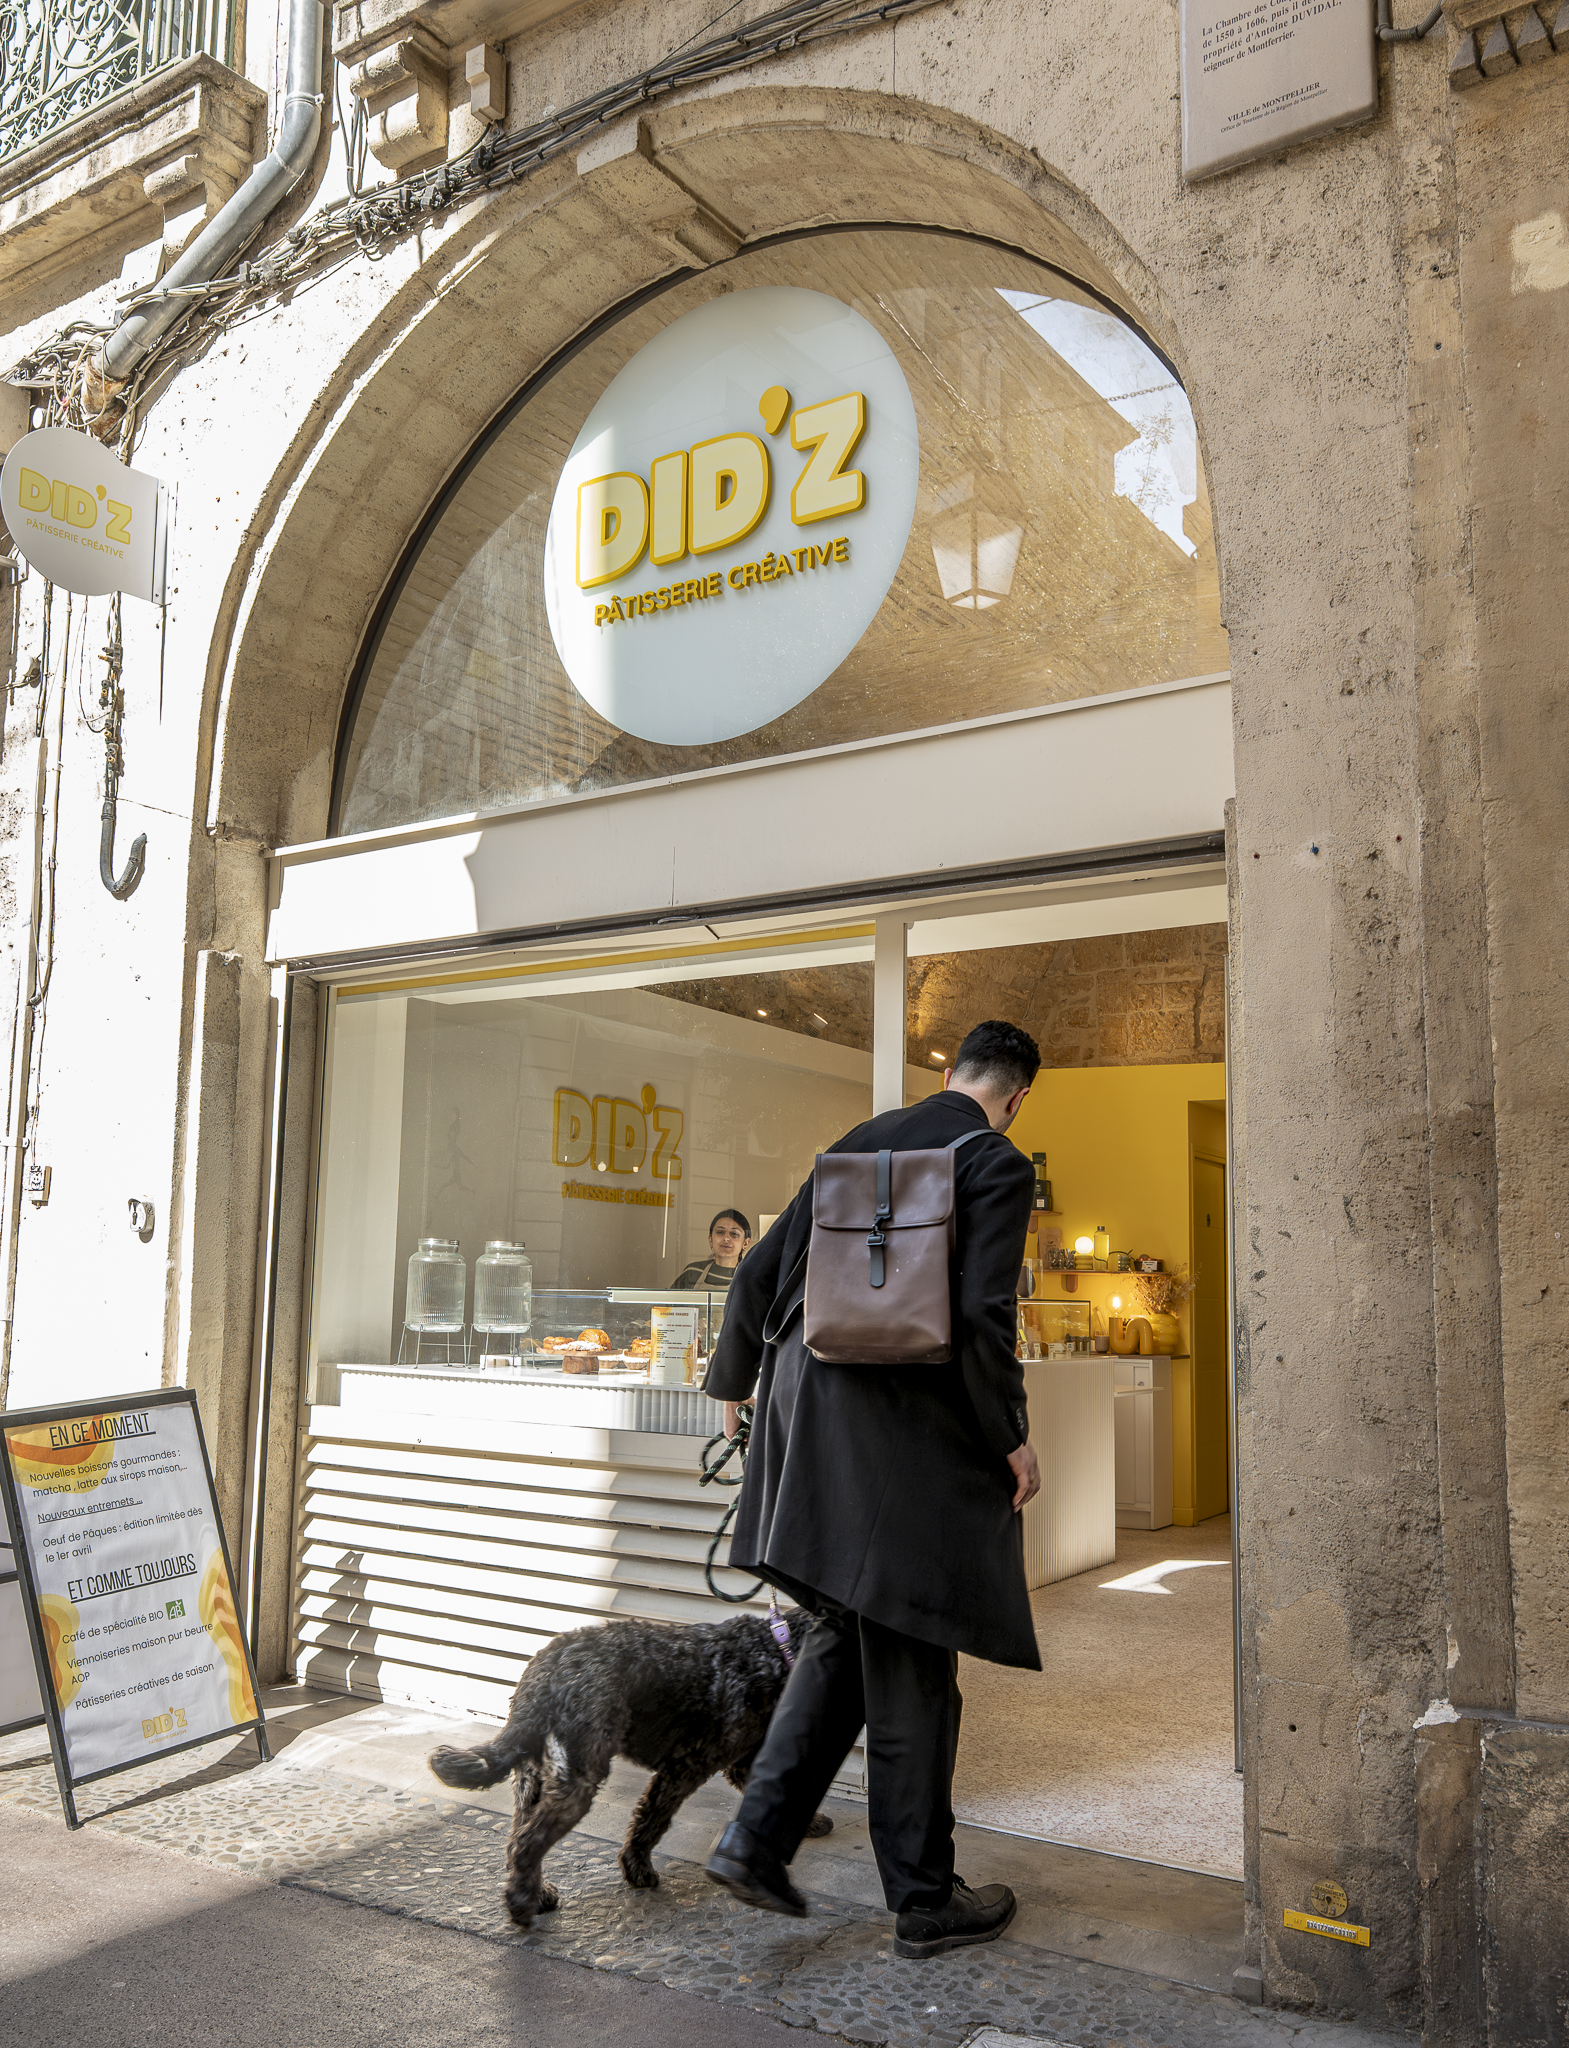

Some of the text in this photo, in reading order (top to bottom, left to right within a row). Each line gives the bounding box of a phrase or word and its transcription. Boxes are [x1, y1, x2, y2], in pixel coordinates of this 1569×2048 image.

[1202, 27, 1213, 37] La
[1215, 10, 1252, 31] Chambre
[1254, 3, 1268, 14] des
[1202, 39, 1212, 49] de
[1216, 28, 1235, 43] 1550
[1237, 25, 1243, 34] à
[1246, 15, 1268, 31] 1606,
[1271, 6, 1289, 22] puis
[1292, 1, 1298, 11] il
[1203, 0, 1342, 63] propriété d'Antoine DUVIDAL,
[1203, 31, 1295, 74] seigneur de Montferrier.
[1227, 108, 1252, 122] VILLE
[1261, 81, 1320, 110] MONTPELLIER
[1242, 113, 1264, 125] Tourisme
[1275, 101, 1293, 112] Région
[1300, 88, 1328, 103] Montpellier
[18, 467, 132, 545] DID'Z
[575, 385, 867, 590] DID'Z
[26, 518, 124, 559] PÂTISSERIE CRÉATIVE
[594, 536, 849, 627] PÂTISSERIE CRÉATIVE
[49, 1412, 150, 1447] EN CE MOMENT
[29, 1467, 76, 1483] Nouvelles
[77, 1459, 119, 1474] boissons
[120, 1449, 177, 1468] gourmandes
[32, 1482, 72, 1498] matcha
[77, 1476, 99, 1490] latte
[100, 1475, 118, 1486] aux
[119, 1469, 146, 1484] sirops
[37, 1506, 86, 1523] Nouveaux
[87, 1497, 135, 1513] entremets
[42, 1533, 66, 1548] Oeuf
[68, 1532, 81, 1543] de
[82, 1524, 118, 1540] Pâques
[123, 1517, 155, 1531] édition
[155, 1510, 186, 1524] limitée
[187, 1506, 203, 1518] dès
[45, 1553, 55, 1564] le
[71, 1544, 93, 1558] avril
[67, 1553, 196, 1600] ET COMME TOUJOURS
[62, 1630, 86, 1644] Café
[87, 1627, 101, 1638] de
[102, 1615, 148, 1635] spécialité
[148, 1610, 164, 1622] BIO
[66, 1622, 214, 1669] Viennoiseries maison pur beurre
[71, 1671, 91, 1685] AOP
[75, 1662, 215, 1711] Pâtisseries créatives de saison
